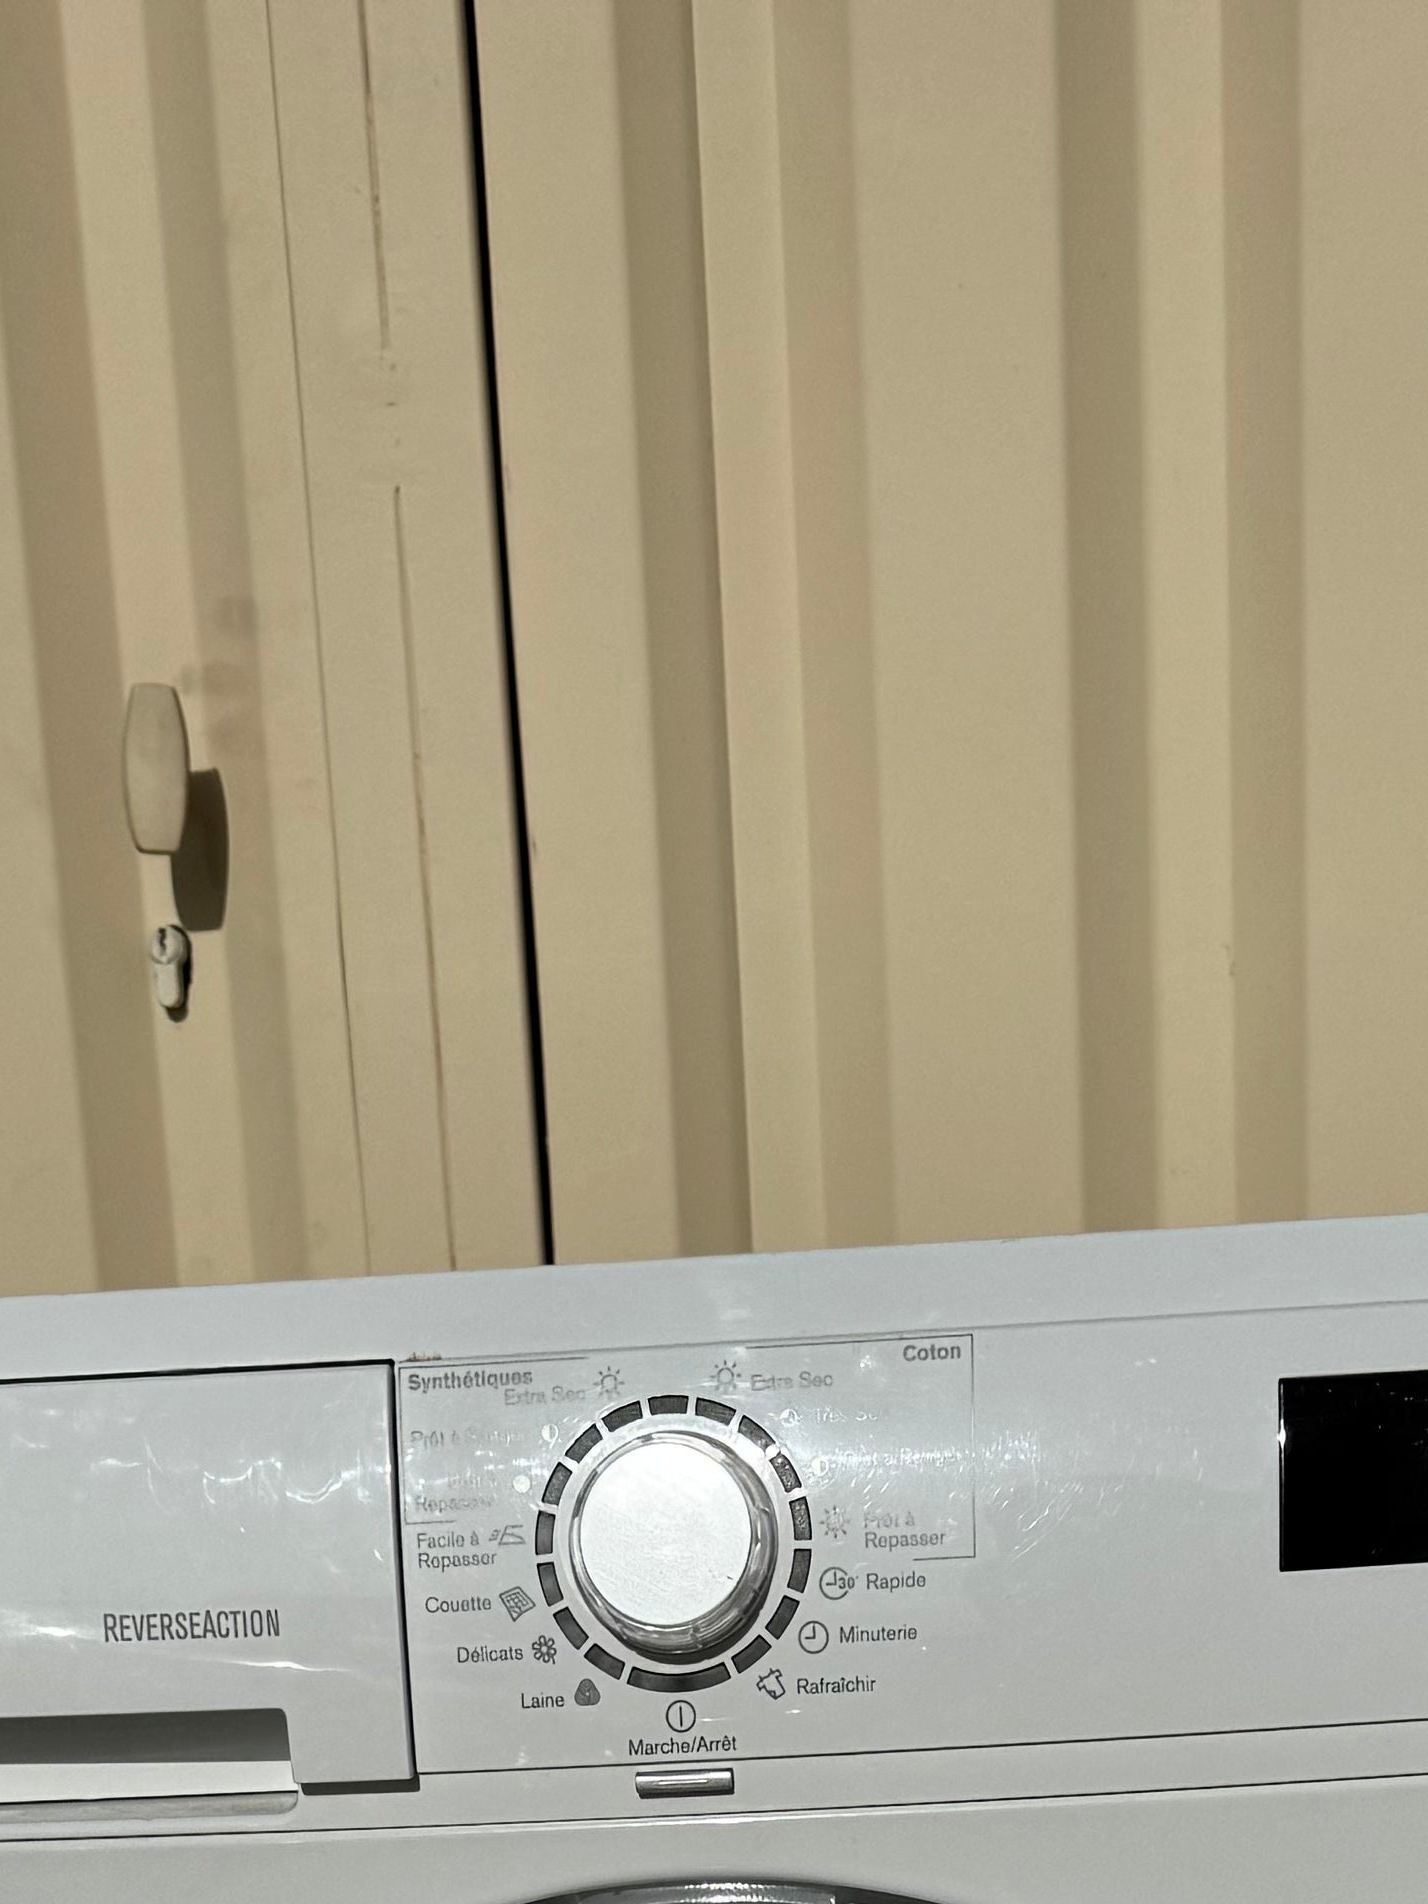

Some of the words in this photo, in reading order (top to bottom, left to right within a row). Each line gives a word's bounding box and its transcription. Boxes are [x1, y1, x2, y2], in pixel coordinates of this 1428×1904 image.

[902, 1342, 962, 1363] Coton
[407, 1368, 534, 1393] Synthétiques
[798, 1370, 834, 1388] Sec
[417, 1529, 465, 1550] Facile
[864, 1529, 946, 1551] Repasser
[417, 1551, 497, 1573] Repasser
[866, 1571, 926, 1592] Rapide
[425, 1594, 492, 1614] Couette
[102, 1608, 282, 1645] REVERSEACTION
[839, 1623, 918, 1644] Minuterie
[457, 1643, 524, 1664] Délicats
[796, 1674, 876, 1695] Rafraîchir
[521, 1691, 565, 1711] Laine
[628, 1735, 737, 1757] Marche/Arrêt
